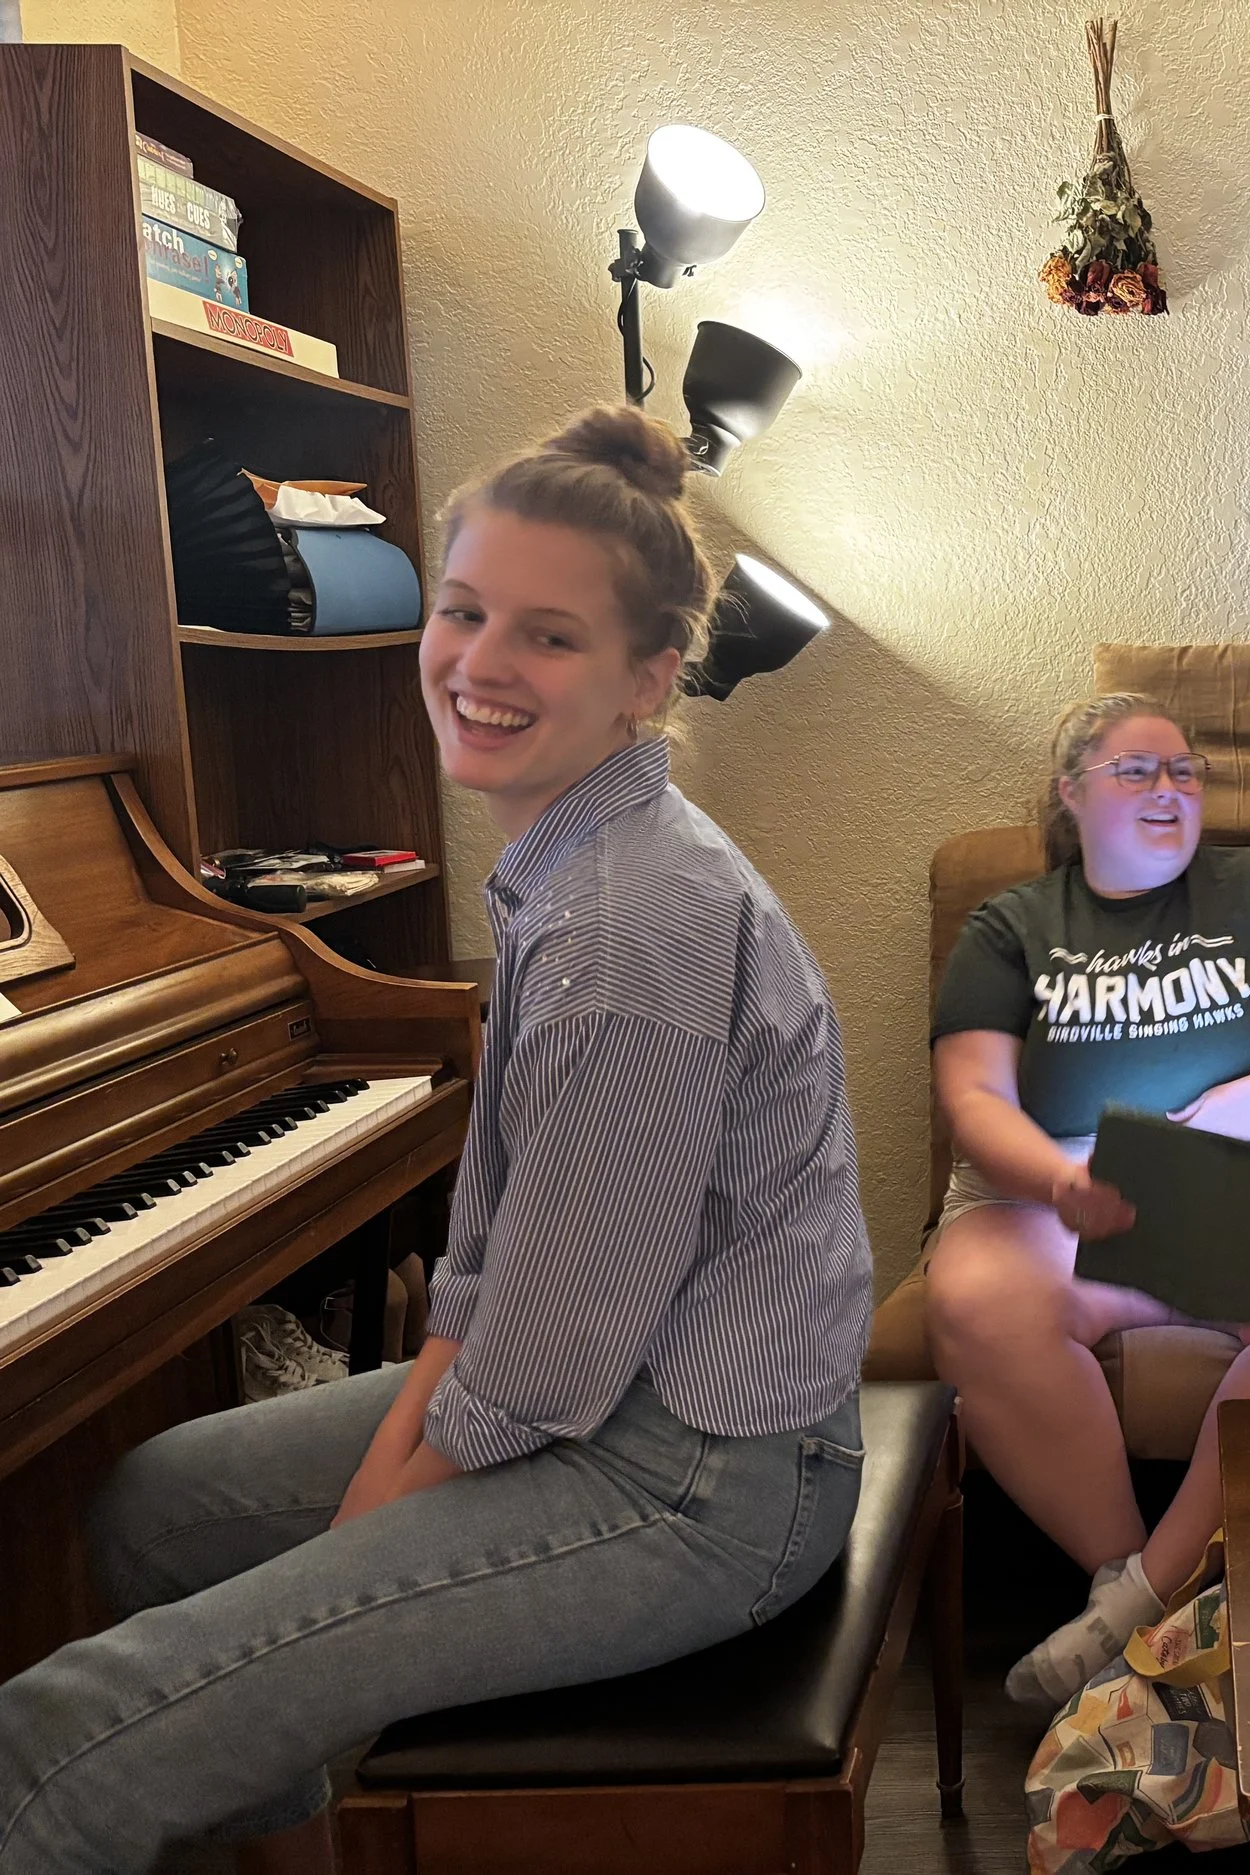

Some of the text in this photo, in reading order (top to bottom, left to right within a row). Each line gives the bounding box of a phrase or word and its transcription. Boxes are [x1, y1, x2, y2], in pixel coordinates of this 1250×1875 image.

[186, 201, 211, 230] CUES
[207, 303, 289, 353] MONOPOLY
[1086, 932, 1193, 974] hawks in
[1033, 957, 1250, 1024] HARMONY
[1129, 1016, 1190, 1039] SINGING
[1193, 1003, 1245, 1031] HAWKS
